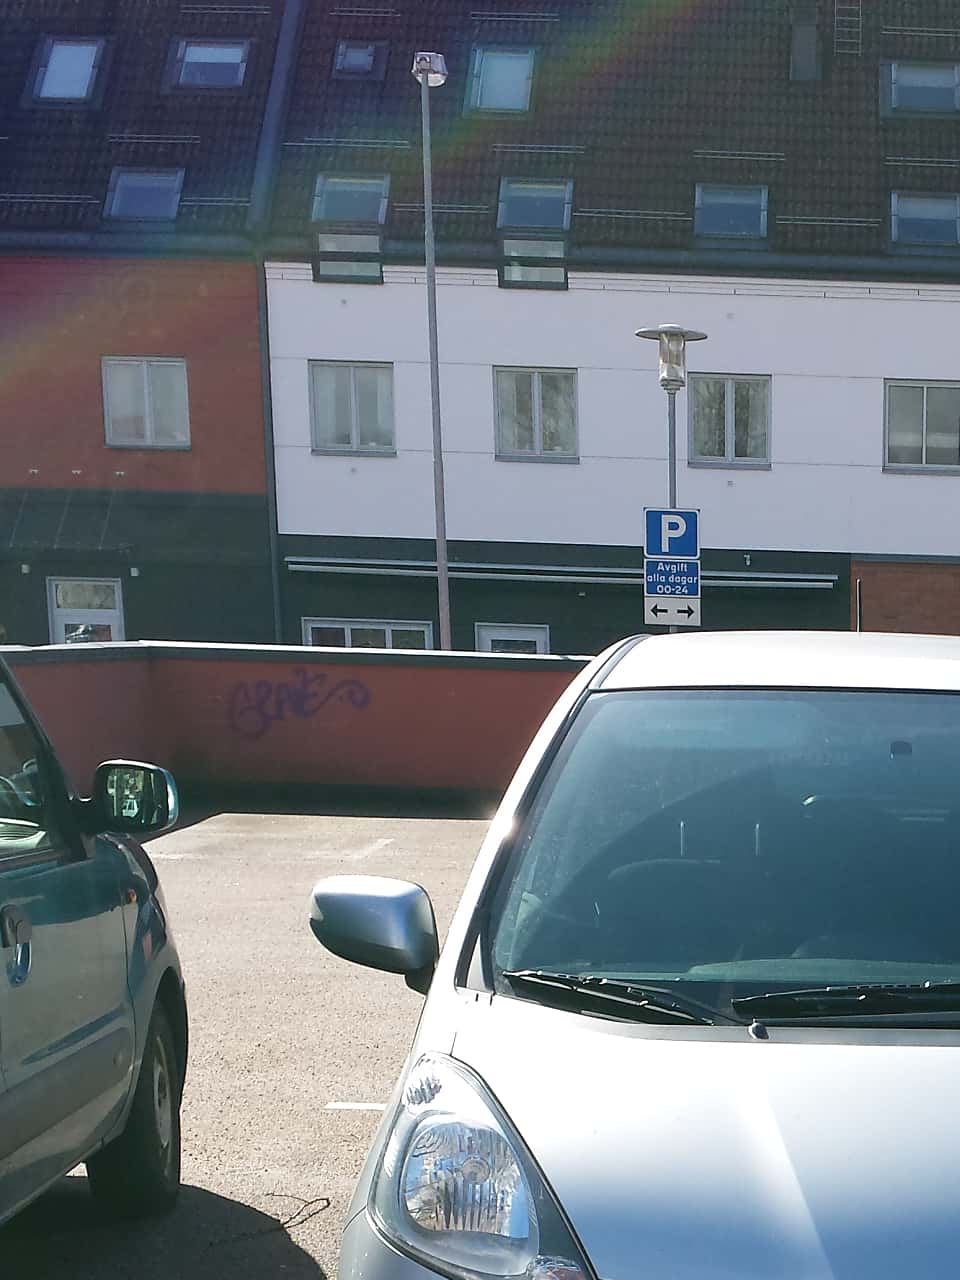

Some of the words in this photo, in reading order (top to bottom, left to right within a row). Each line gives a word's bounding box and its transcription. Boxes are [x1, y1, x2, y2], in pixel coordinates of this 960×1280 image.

[661, 514, 687, 553] P
[657, 562, 688, 573] Avgift
[647, 573, 666, 582] alla
[669, 574, 698, 584] dagar
[656, 585, 688, 594] 00-24
